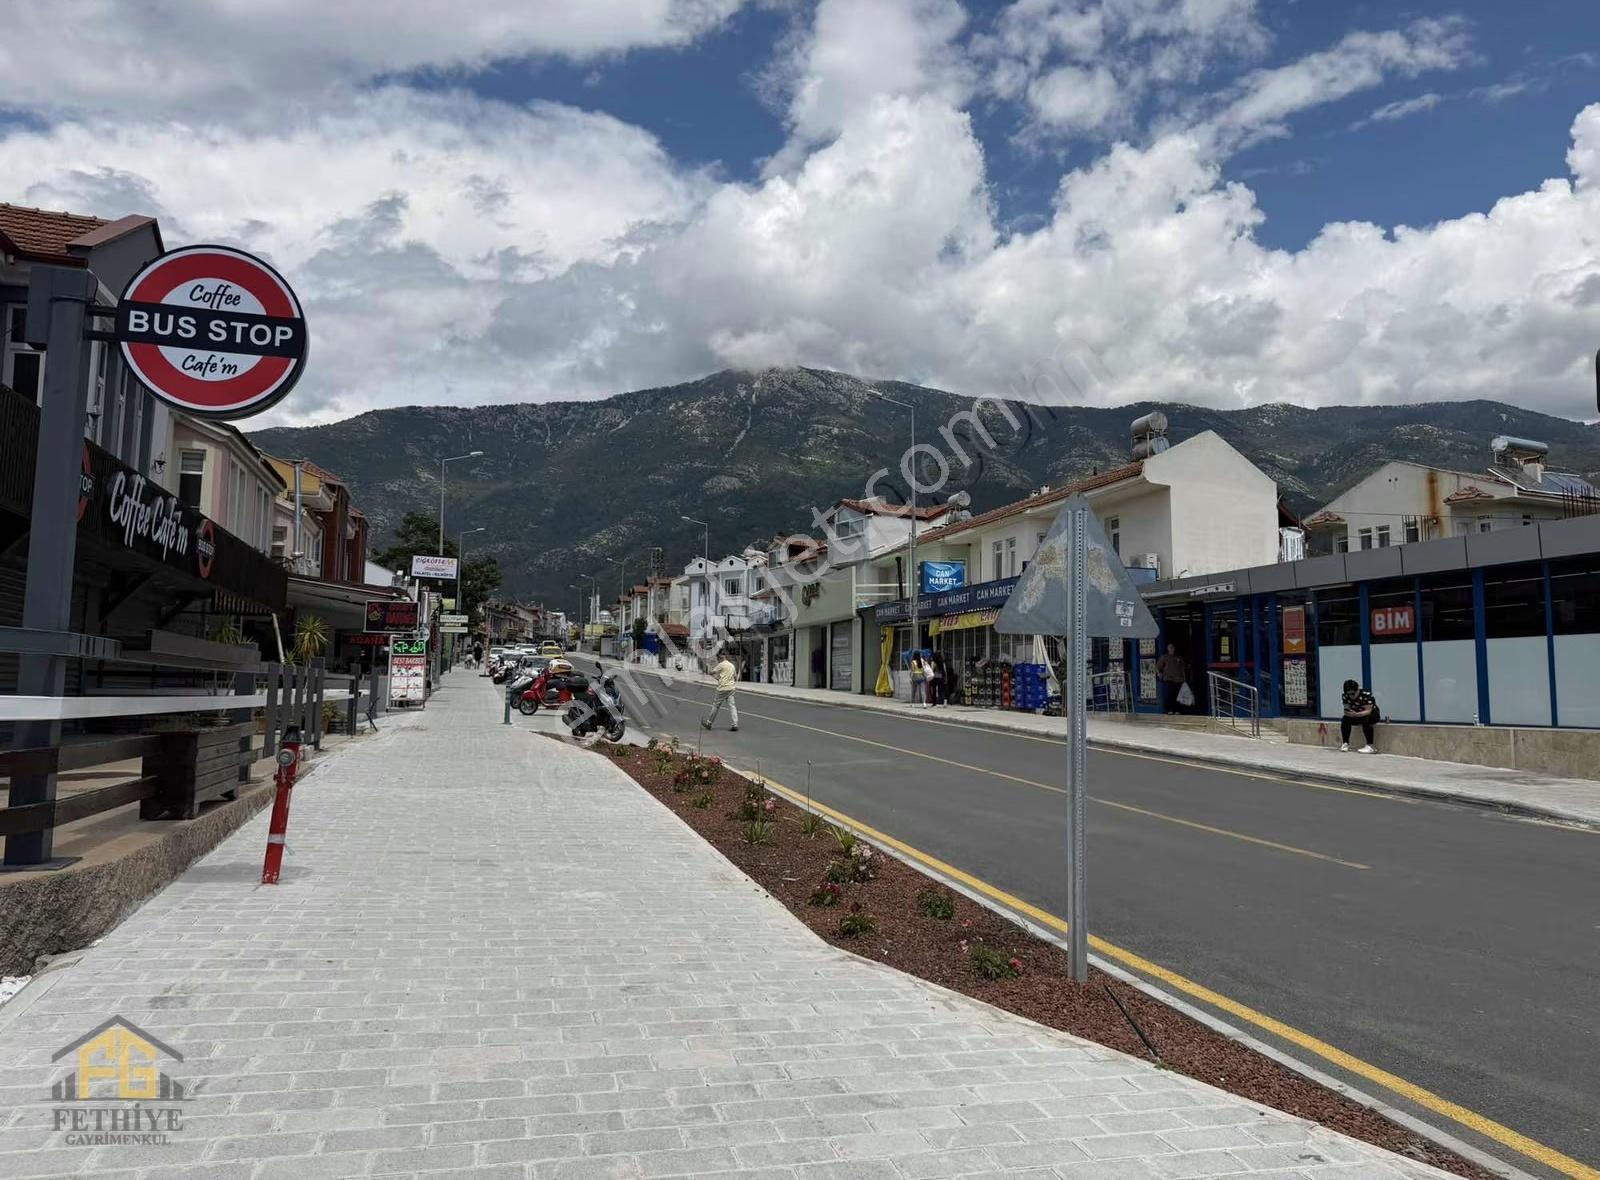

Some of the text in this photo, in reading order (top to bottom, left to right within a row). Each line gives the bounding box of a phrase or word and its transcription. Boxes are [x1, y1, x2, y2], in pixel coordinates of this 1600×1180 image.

[189, 284, 241, 310] Coffee
[128, 311, 293, 347] BUS STOP
[181, 354, 238, 377] Cafe'm
[110, 471, 150, 548] Coffee
[935, 570, 950, 578] CAN
[937, 592, 970, 608] CAN MARKET
[976, 584, 1015, 600] CAN MARKET
[884, 605, 900, 616] MARKET
